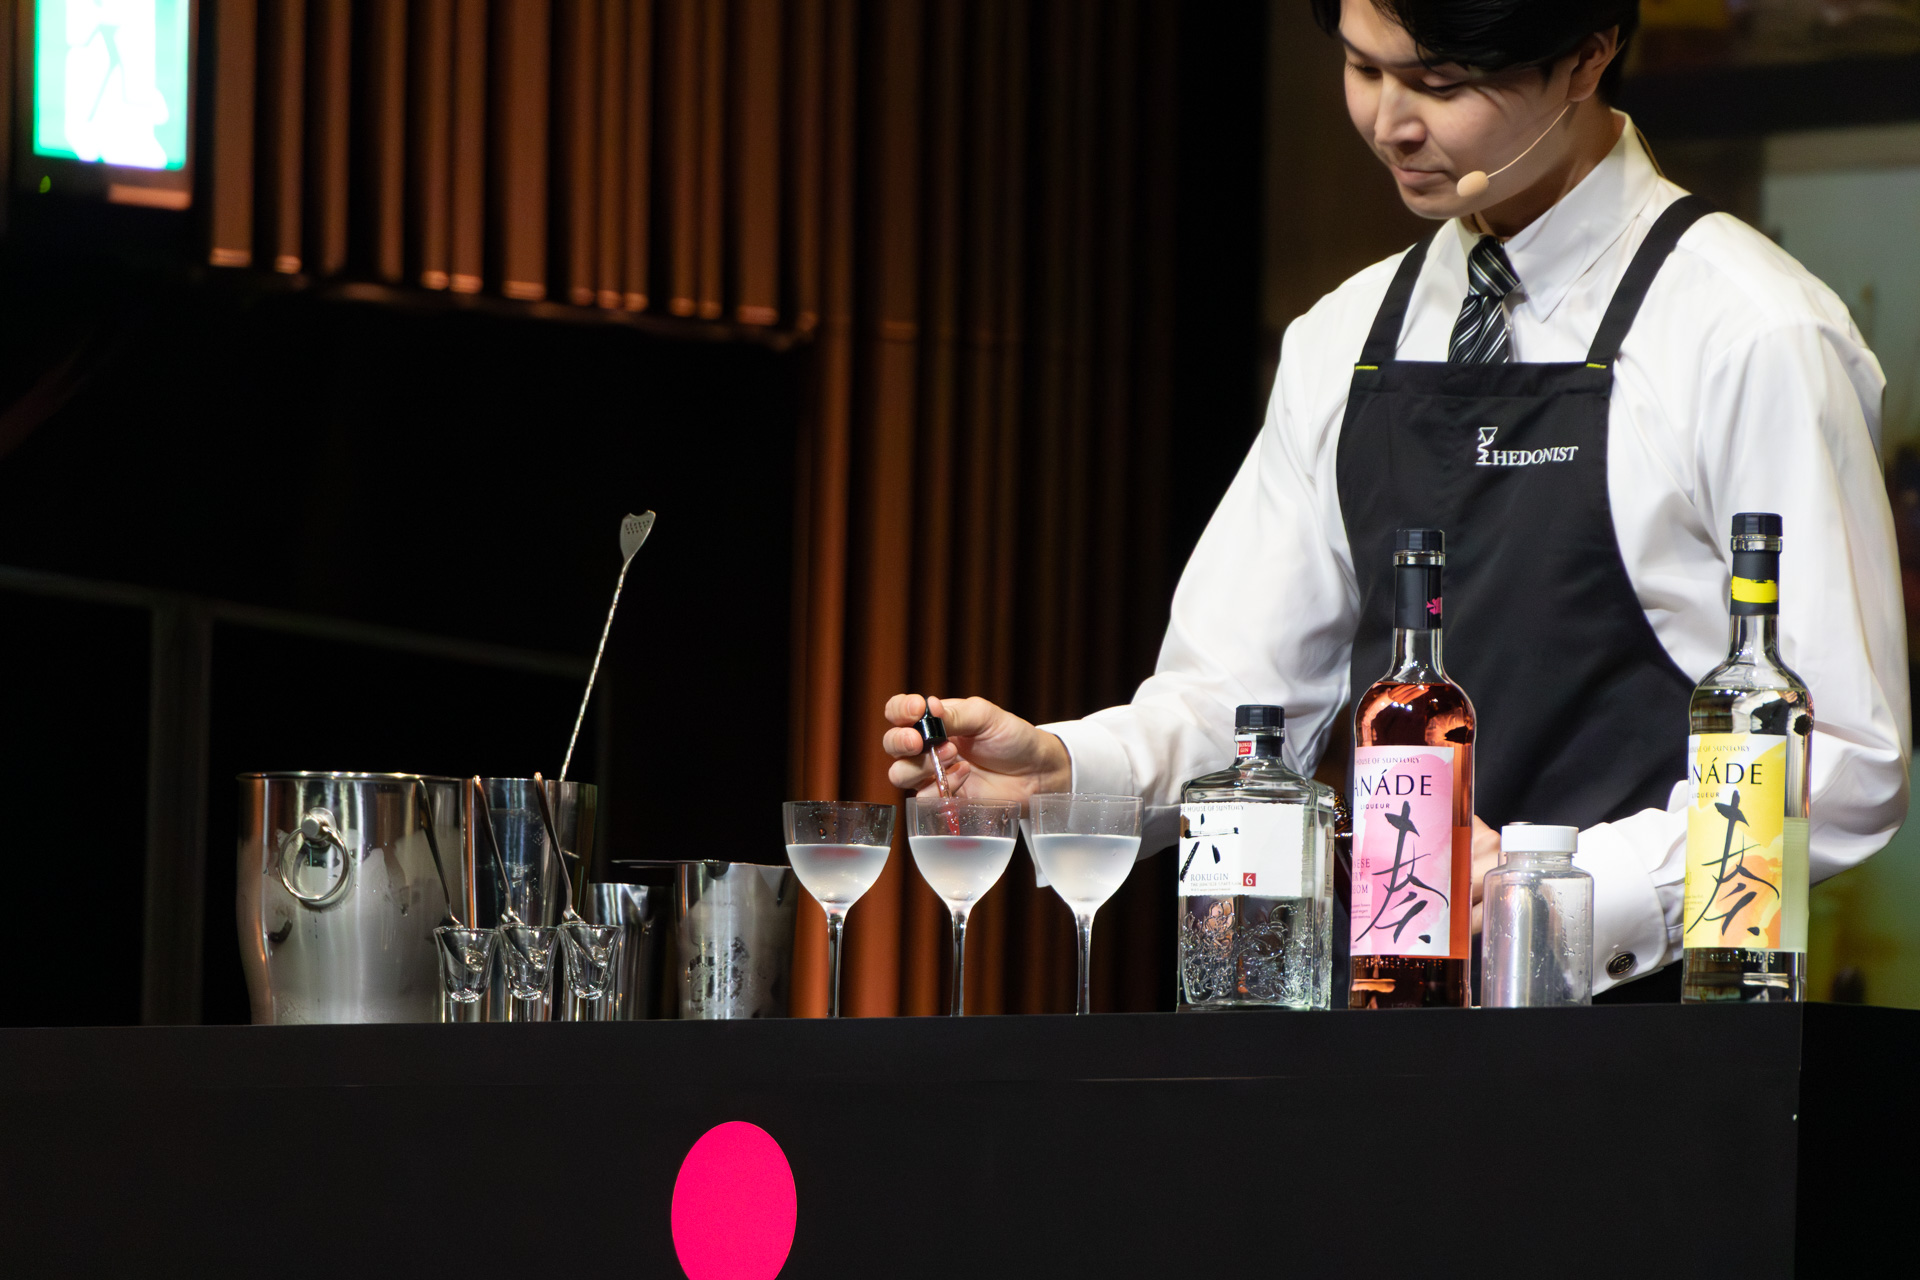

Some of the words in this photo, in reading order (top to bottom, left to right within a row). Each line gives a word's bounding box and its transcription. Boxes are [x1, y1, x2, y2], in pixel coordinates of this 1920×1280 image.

[1492, 446, 1579, 466] HEDONIST
[1190, 873, 1212, 882] ROKU
[1213, 872, 1229, 881] GIN
[1245, 874, 1254, 886] 6
